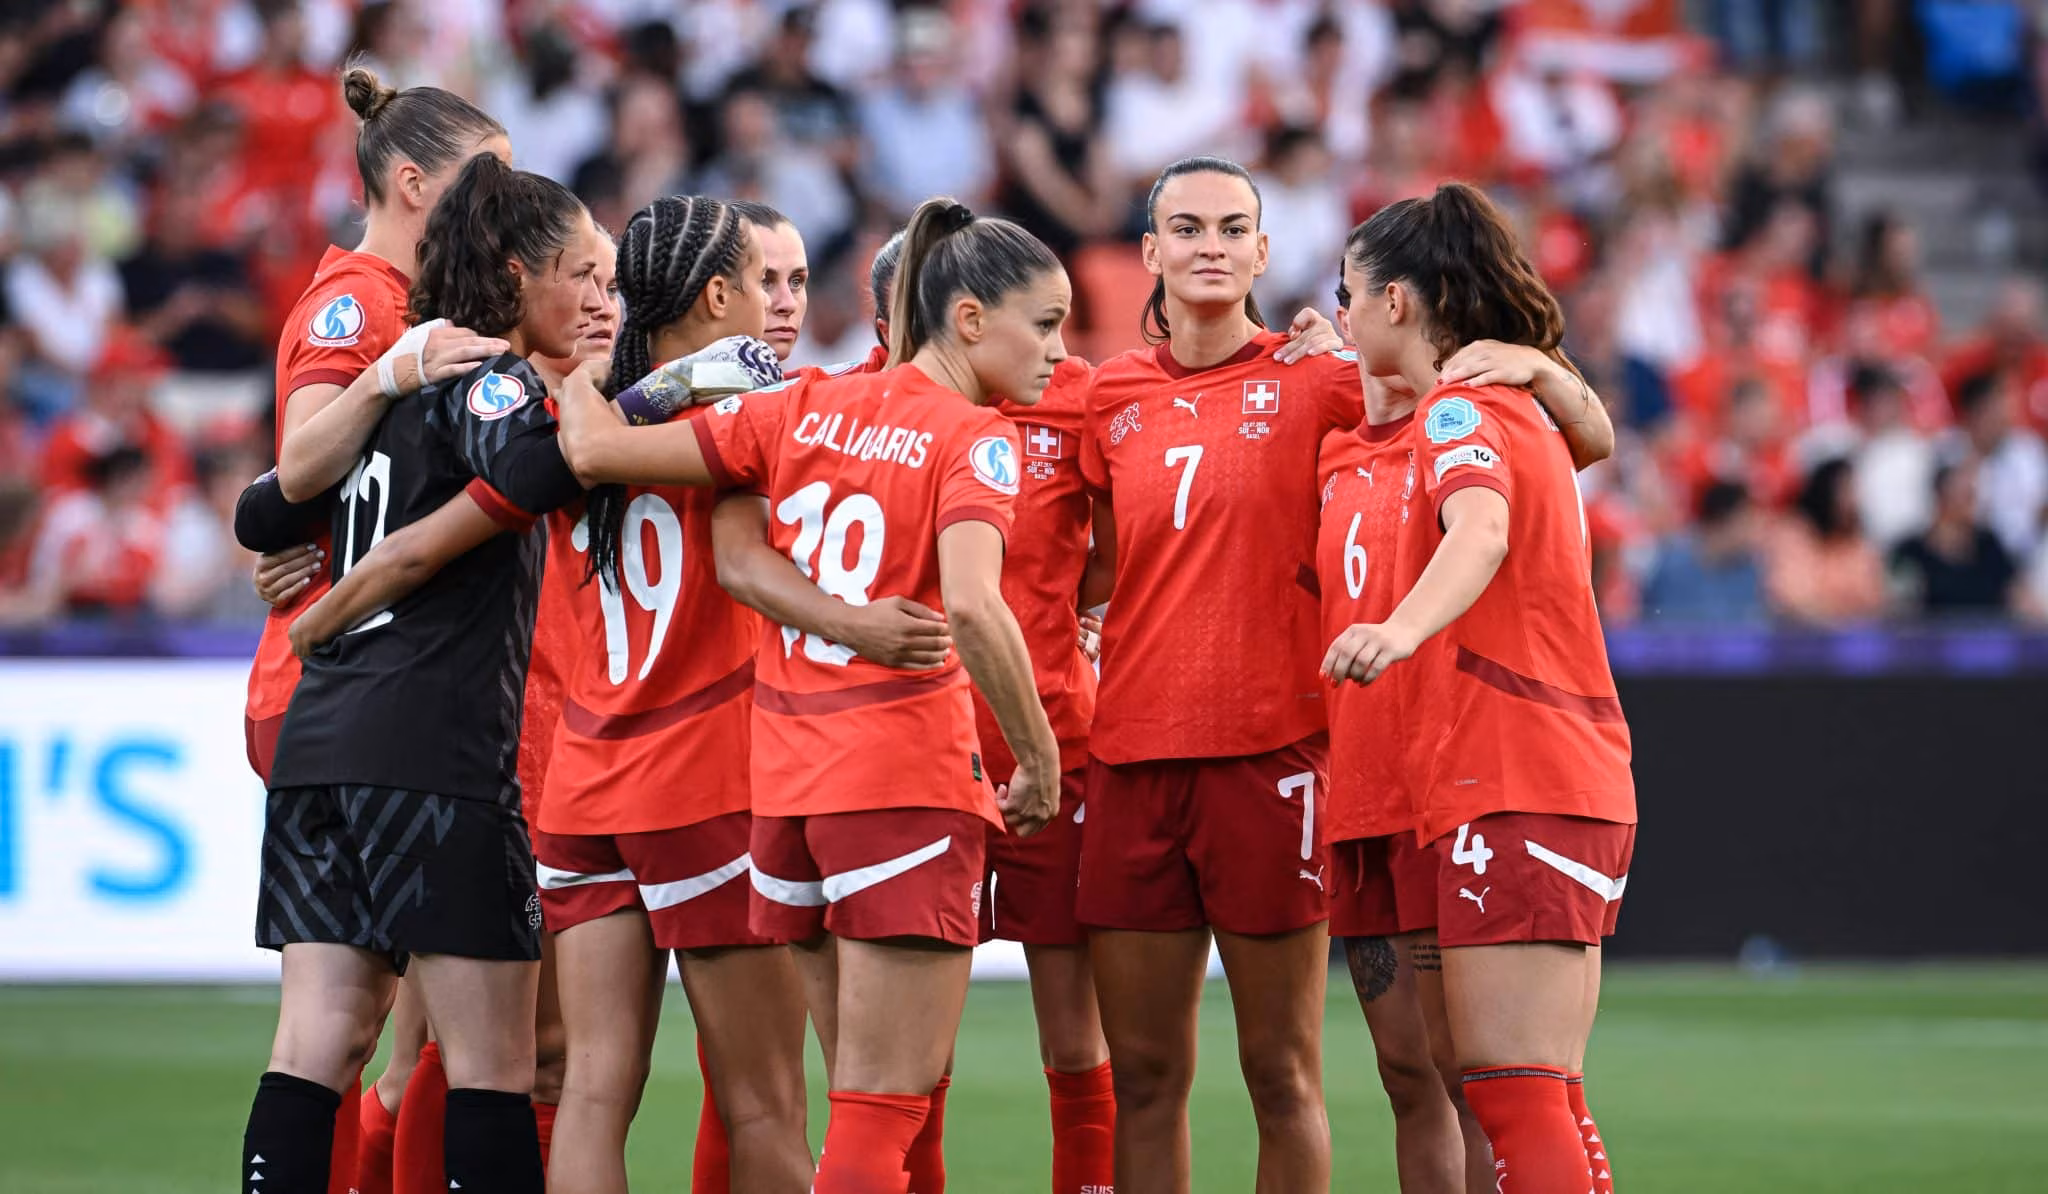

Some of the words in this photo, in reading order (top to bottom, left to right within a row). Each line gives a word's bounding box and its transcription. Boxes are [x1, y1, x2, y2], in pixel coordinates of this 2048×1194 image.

[1165, 444, 1204, 531] 7
[571, 492, 684, 686] 19
[776, 480, 885, 667] 18
[1343, 511, 1368, 600] 6
[1277, 771, 1316, 861] 7
[1451, 823, 1494, 876] 4
